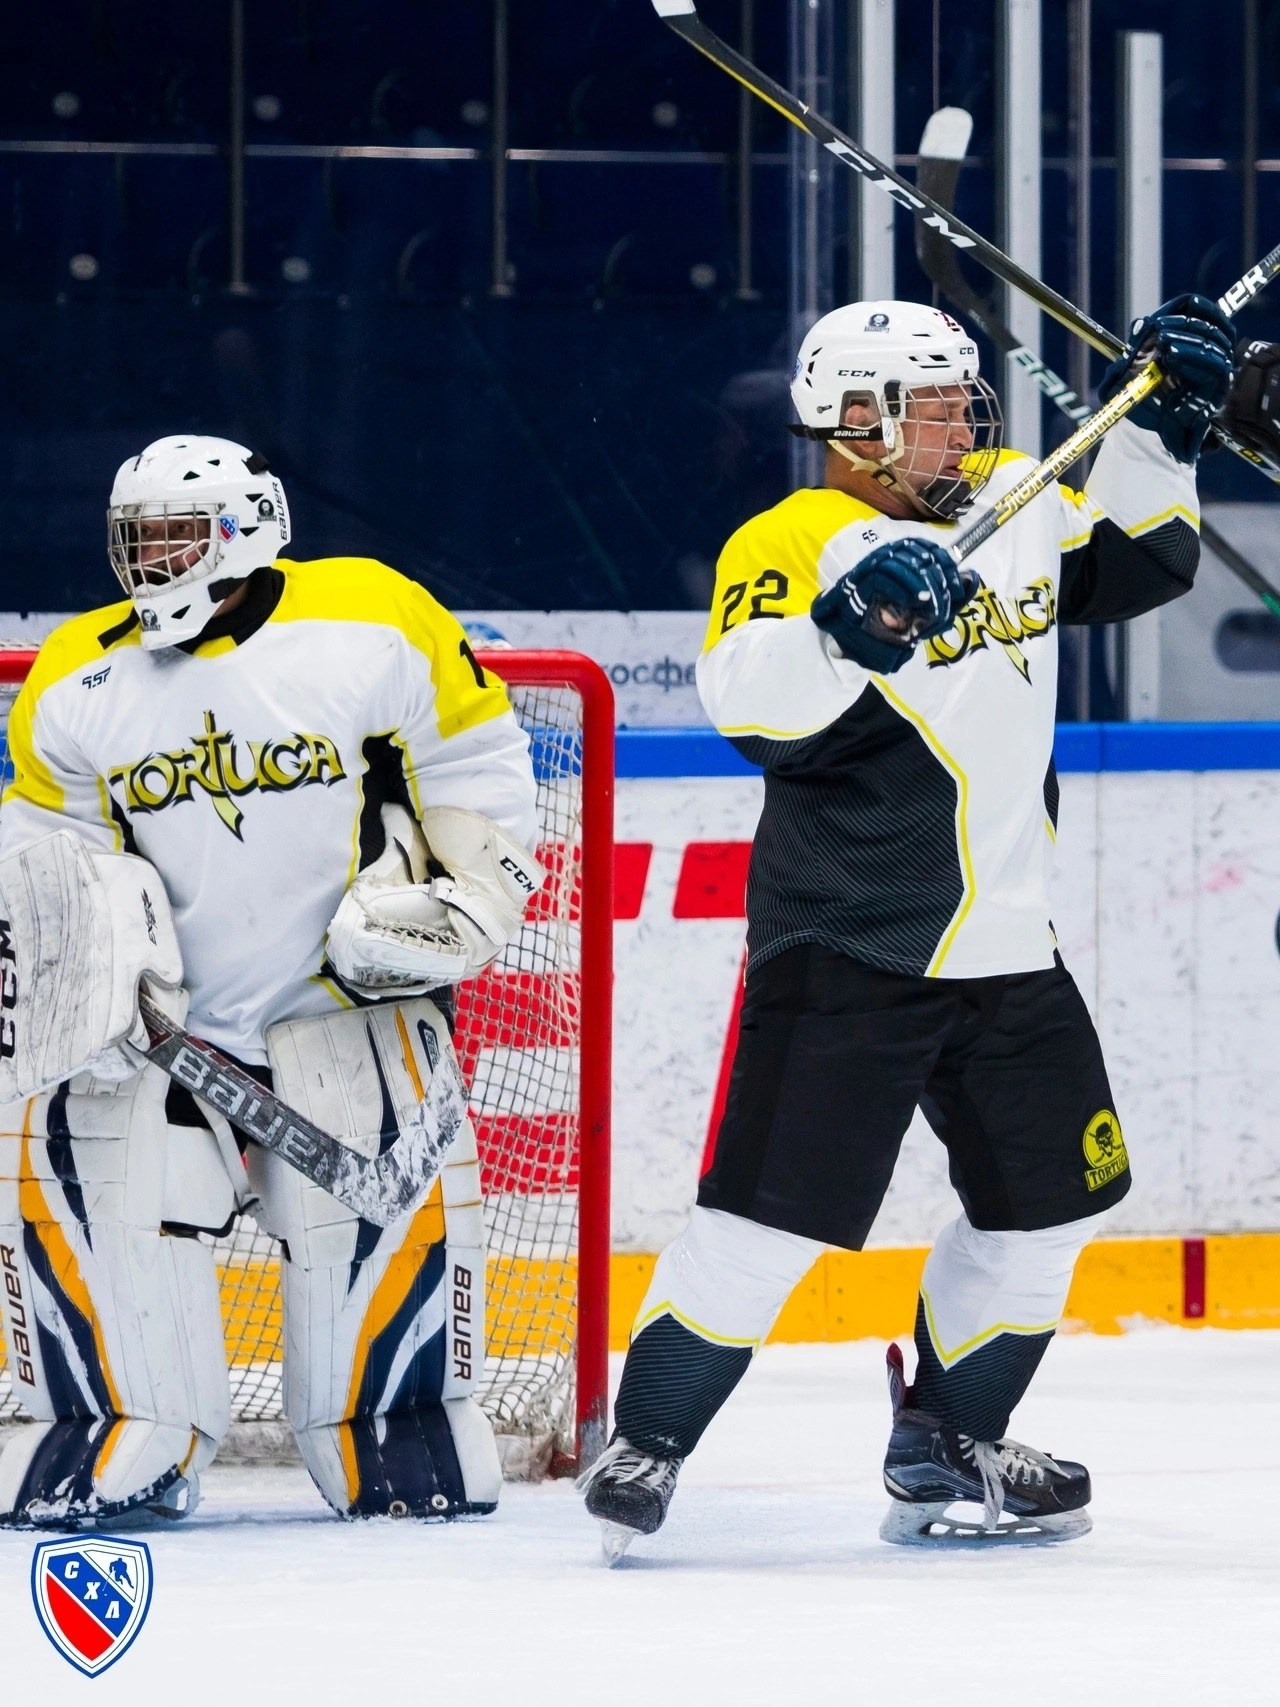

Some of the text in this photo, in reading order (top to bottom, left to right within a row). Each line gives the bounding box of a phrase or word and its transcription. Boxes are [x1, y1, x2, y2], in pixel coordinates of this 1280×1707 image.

[823, 137, 977, 248] CCM
[838, 369, 876, 378] CCM
[1007, 345, 1096, 428] BAU
[833, 429, 870, 437] BAUER
[272, 481, 288, 541] BAUER
[720, 569, 789, 635] 22
[602, 654, 697, 692] осфе
[107, 709, 348, 843] TORTUGA
[500, 856, 535, 893] CCM
[1089, 1153, 1128, 1186] TORTUG
[0, 1243, 36, 1387] BAUER
[453, 1263, 472, 1381] BAUER
